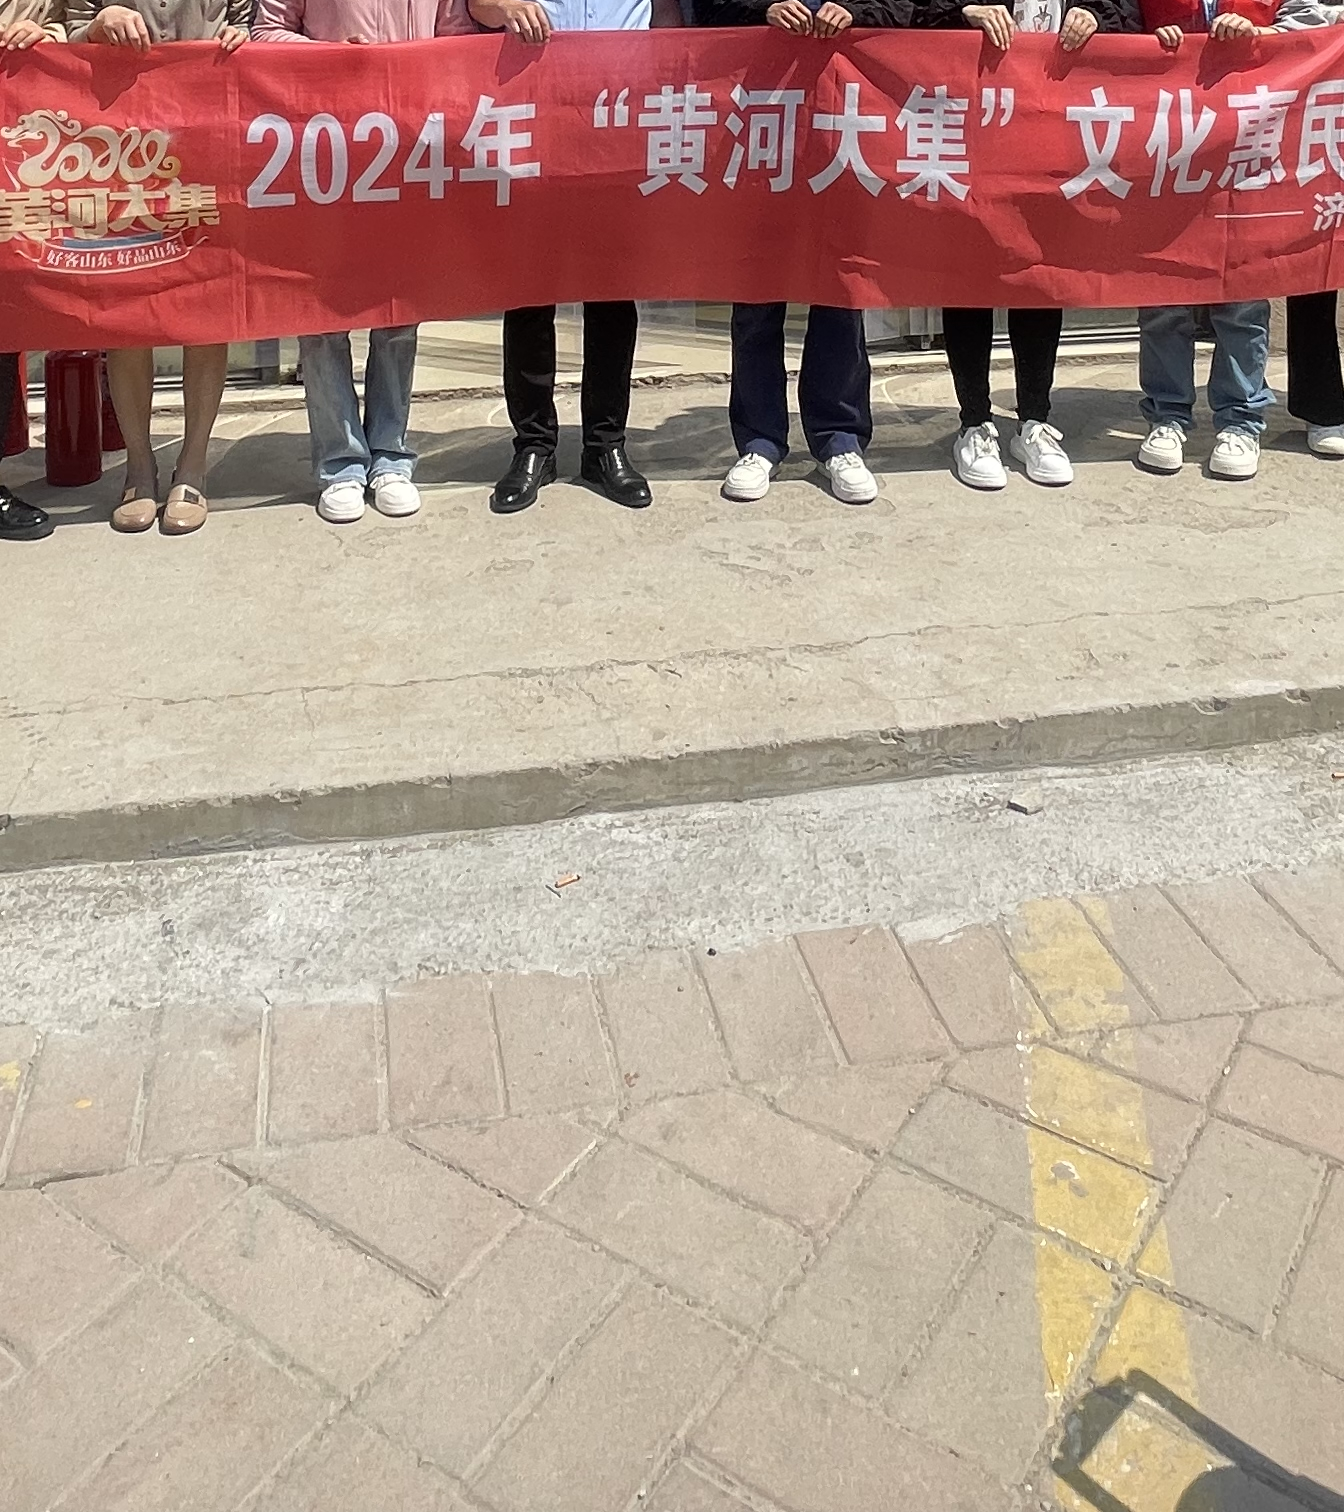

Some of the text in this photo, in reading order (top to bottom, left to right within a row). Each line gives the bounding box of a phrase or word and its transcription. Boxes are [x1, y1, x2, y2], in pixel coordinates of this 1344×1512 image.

[246, 94, 542, 208] 2024年
[593, 82, 1016, 203] “黄河大集”
[46, 240, 182, 269] 好客山东 好品山东
